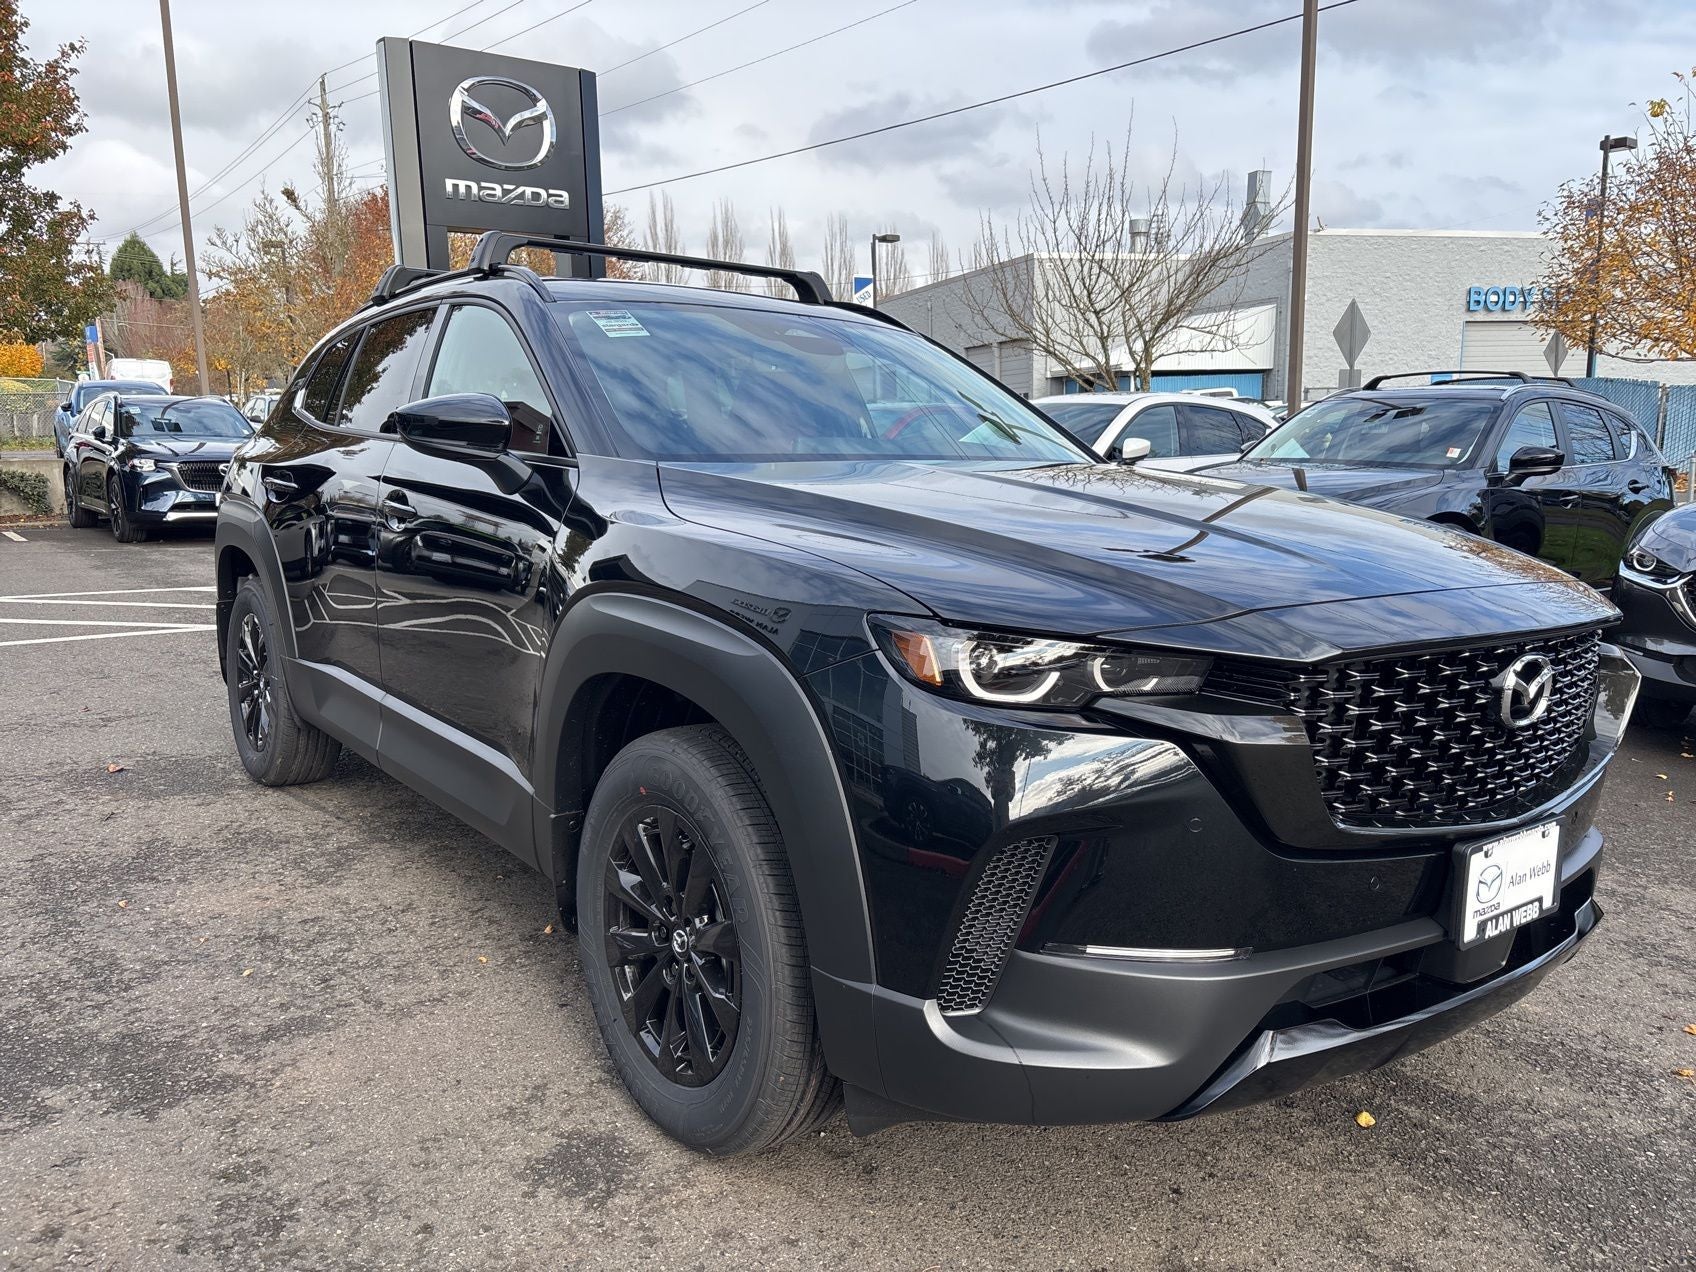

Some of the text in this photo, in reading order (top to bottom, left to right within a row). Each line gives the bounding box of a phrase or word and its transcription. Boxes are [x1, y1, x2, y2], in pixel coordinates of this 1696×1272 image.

[444, 177, 571, 210] mazda
[856, 290, 872, 304] USED
[1468, 285, 1537, 312] BODY
[1507, 859, 1551, 889] Alan Webb
[1484, 901, 1540, 939] ALAN WEBB
